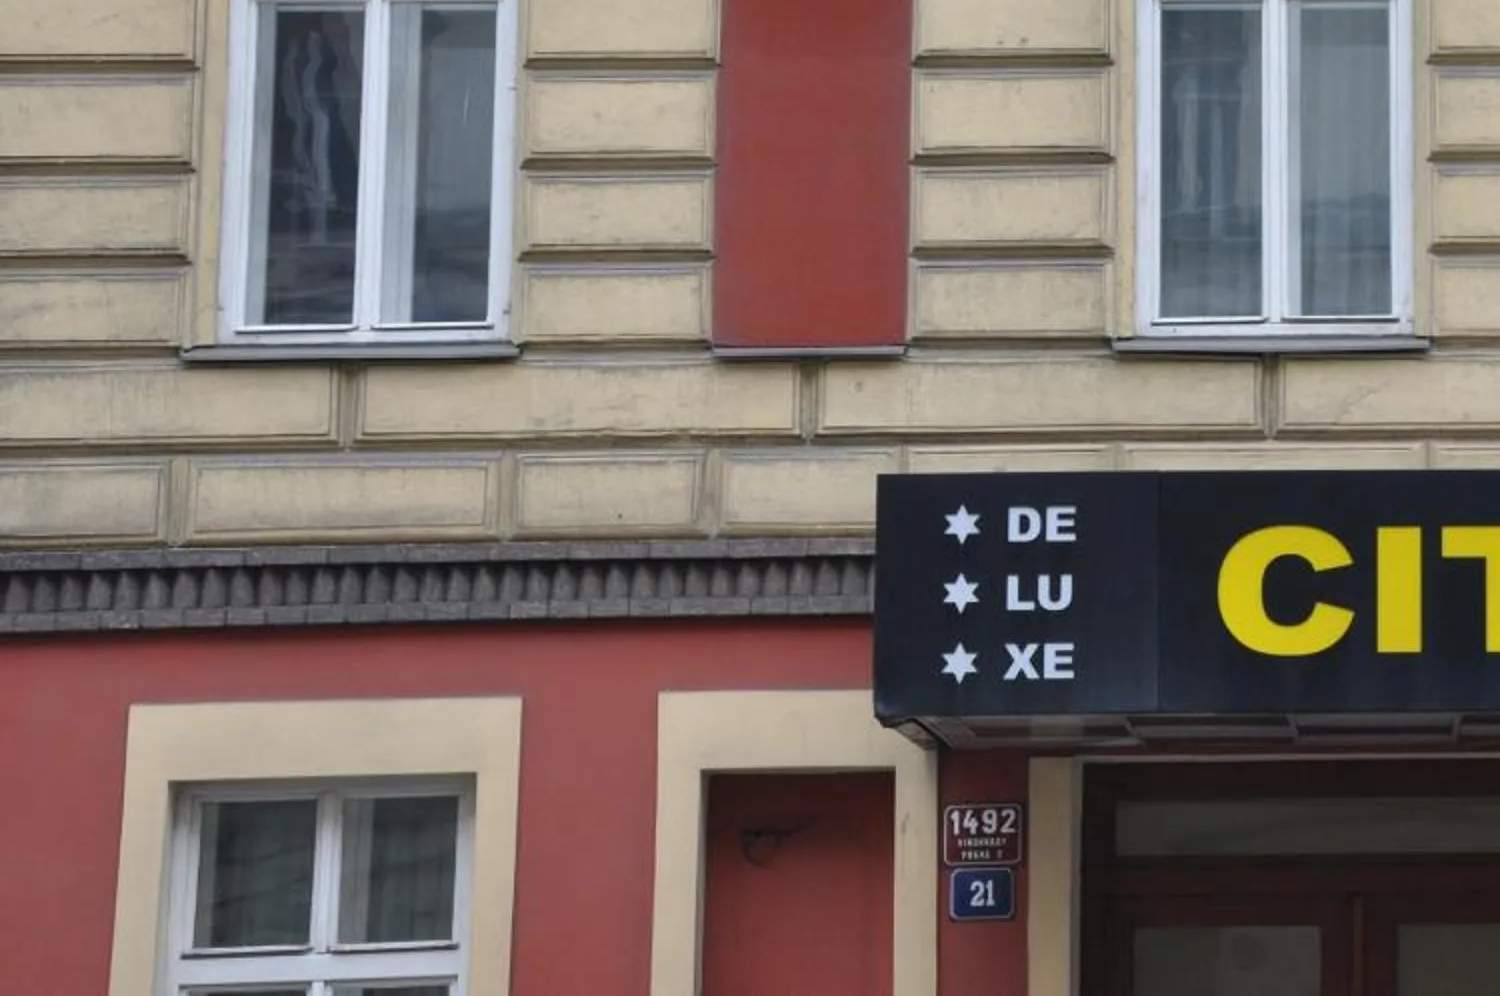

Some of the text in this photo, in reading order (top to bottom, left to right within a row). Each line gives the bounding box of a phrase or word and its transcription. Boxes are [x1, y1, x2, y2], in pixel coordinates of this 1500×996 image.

[1007, 506, 1077, 542] DE
[1005, 574, 1073, 611] LU
[1003, 643, 1075, 680] XE
[950, 808, 1017, 836] 1492
[969, 879, 996, 907] 21
